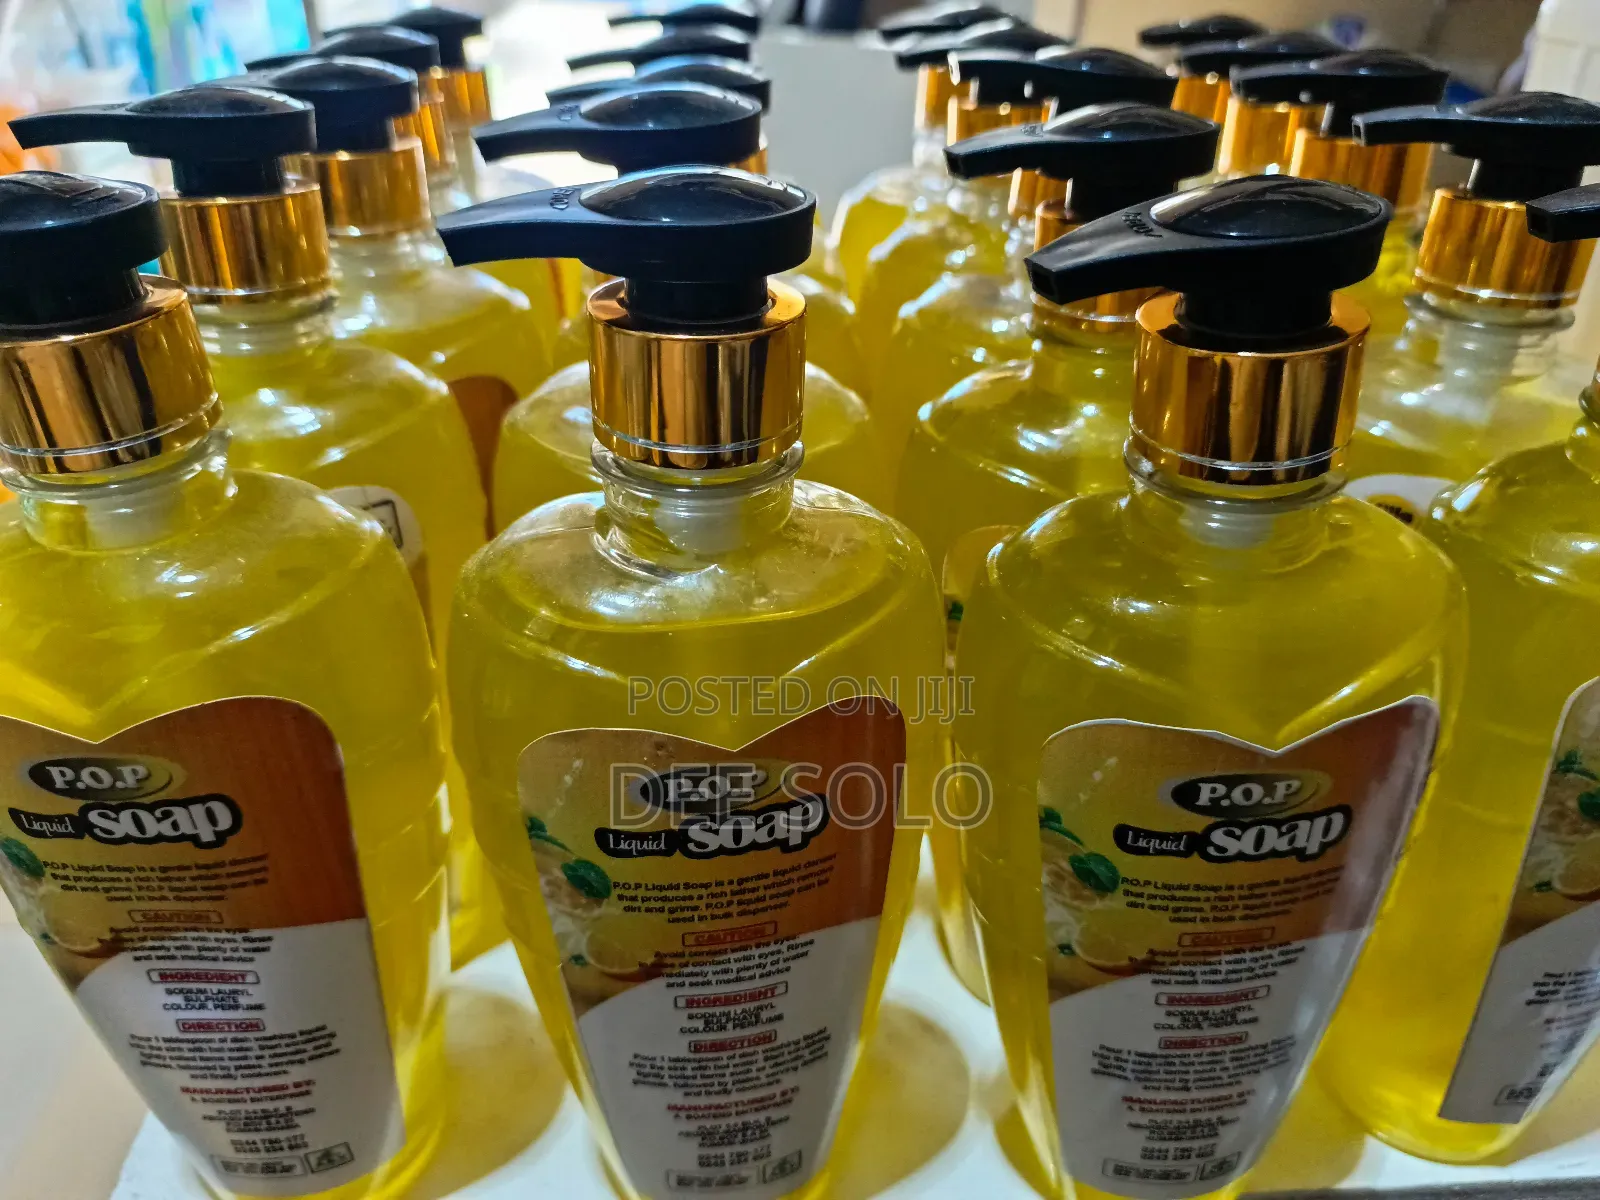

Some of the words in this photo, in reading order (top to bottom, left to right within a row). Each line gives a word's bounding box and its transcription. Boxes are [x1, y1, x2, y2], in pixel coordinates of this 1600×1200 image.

[46, 765, 149, 789] P.O.P
[665, 770, 769, 803] P.O.P
[1195, 780, 1301, 807] P.O.P
[21, 814, 75, 836] Liquid
[88, 801, 233, 842] soap
[608, 832, 668, 855] Liquid
[687, 799, 823, 854] soap
[1127, 831, 1187, 852] Liquid
[1206, 812, 1344, 856] soap
[613, 881, 642, 889] P.O.P
[645, 881, 681, 891] Liquid
[683, 881, 712, 890] Soap
[737, 873, 770, 886] gentle
[772, 864, 802, 878] liquid
[694, 928, 766, 943] CAUTION
[716, 973, 756, 984] medical
[759, 965, 791, 978] advice
[686, 986, 778, 1008] INGREDIENT
[687, 1010, 731, 1020] SODIUM
[734, 1002, 776, 1016] LAURYL
[182, 1022, 260, 1030] DIRECTION
[694, 1032, 772, 1052] DIRECTION
